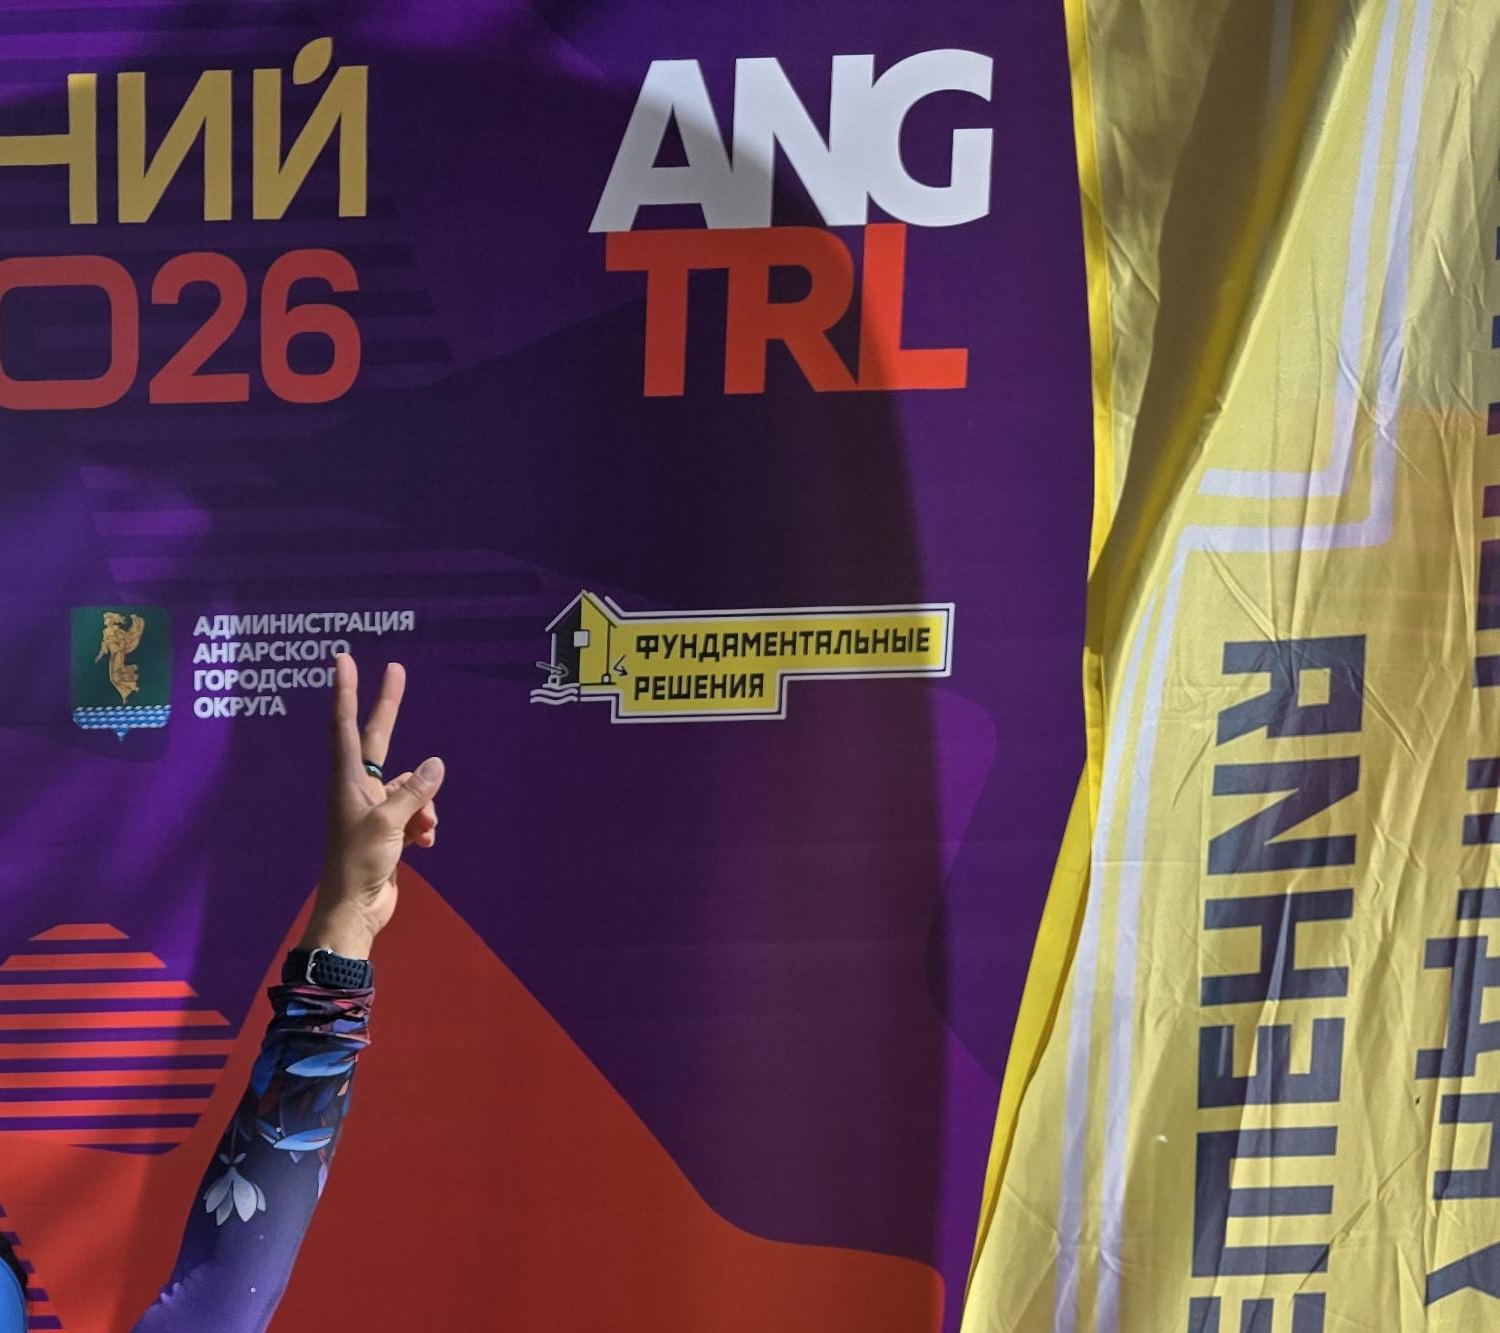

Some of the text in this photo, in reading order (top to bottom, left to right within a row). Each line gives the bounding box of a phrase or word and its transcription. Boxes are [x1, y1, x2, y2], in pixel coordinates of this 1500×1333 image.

[588, 48, 994, 233] ANG
[605, 223, 968, 397] TRL
[193, 610, 415, 640] АДМИНИСТРАЦИЯ
[193, 639, 351, 664] АНГАРСКОГО
[635, 627, 931, 662] ФУНДАМЕНТАЛЬНЫЕ
[194, 667, 338, 692] ГОРОДСКОГ
[634, 673, 764, 700] РЕШЕНИЯ
[193, 695, 287, 718] ОКРУГА
